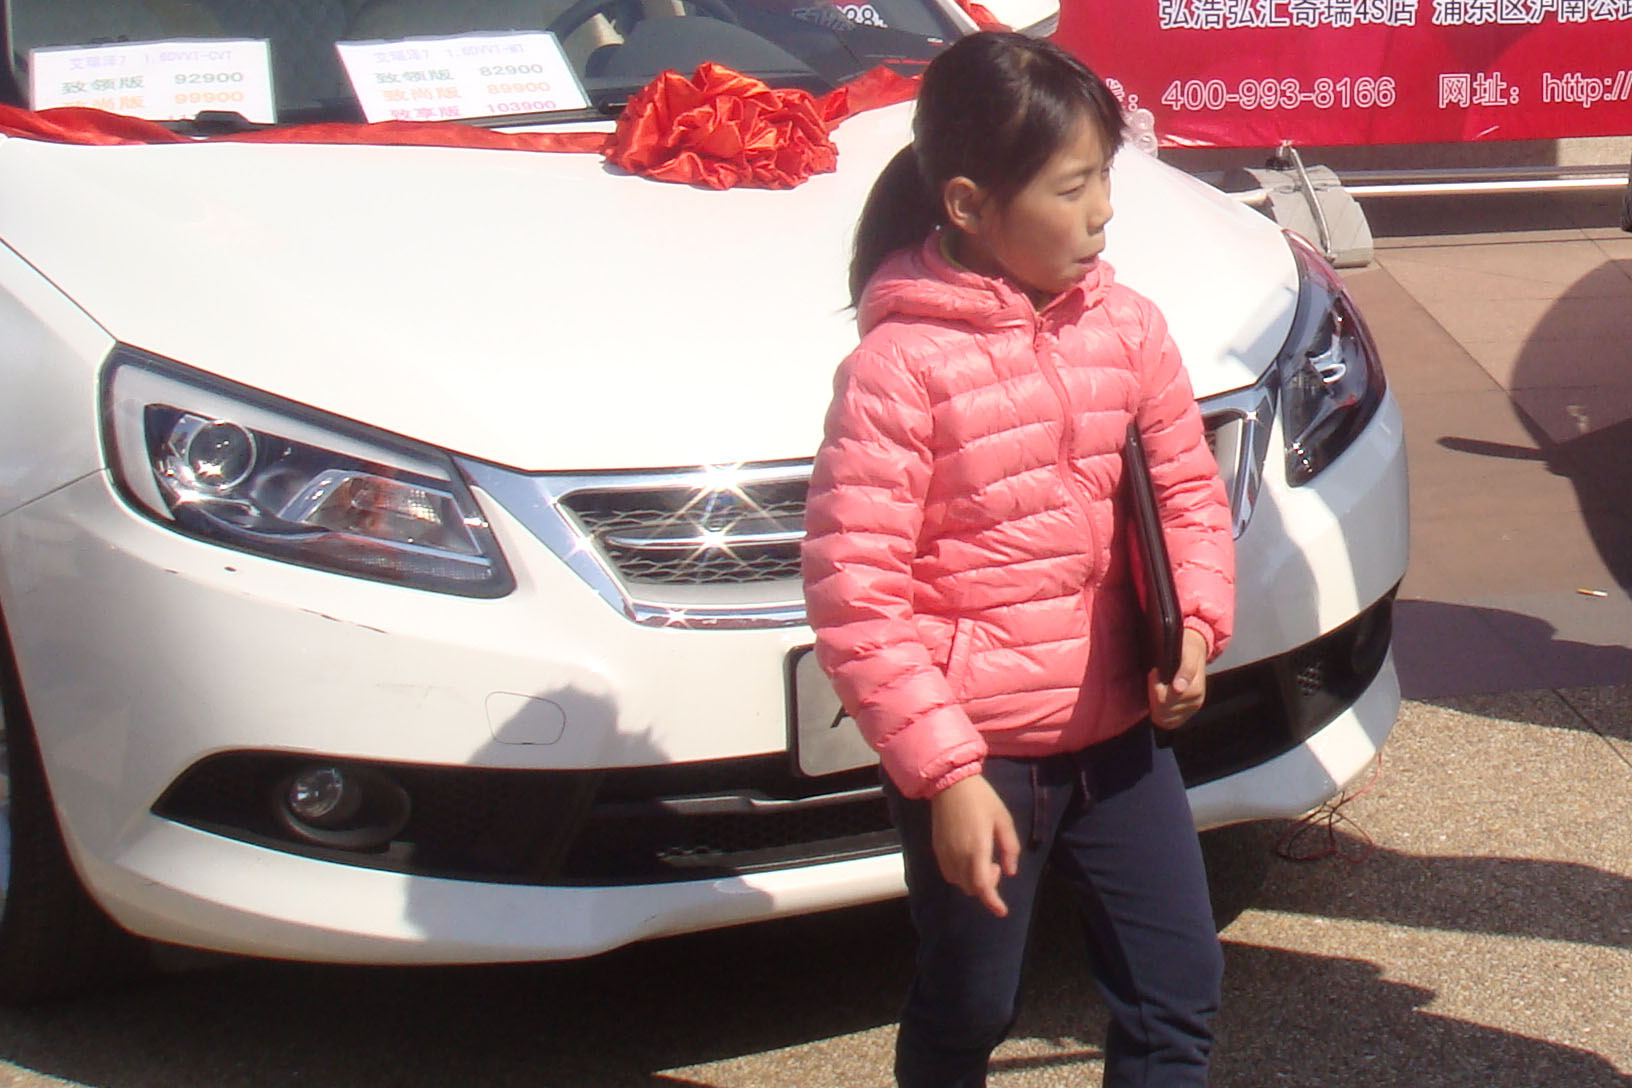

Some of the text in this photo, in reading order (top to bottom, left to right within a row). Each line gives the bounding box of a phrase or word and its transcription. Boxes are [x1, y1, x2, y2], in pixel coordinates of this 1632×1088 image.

[479, 63, 543, 77] 82900
[174, 72, 243, 85] 92900
[486, 81, 551, 95] 89900
[1161, 76, 1396, 110] 400-993-8166
[174, 91, 244, 105] 99900
[487, 100, 556, 114] 103900
